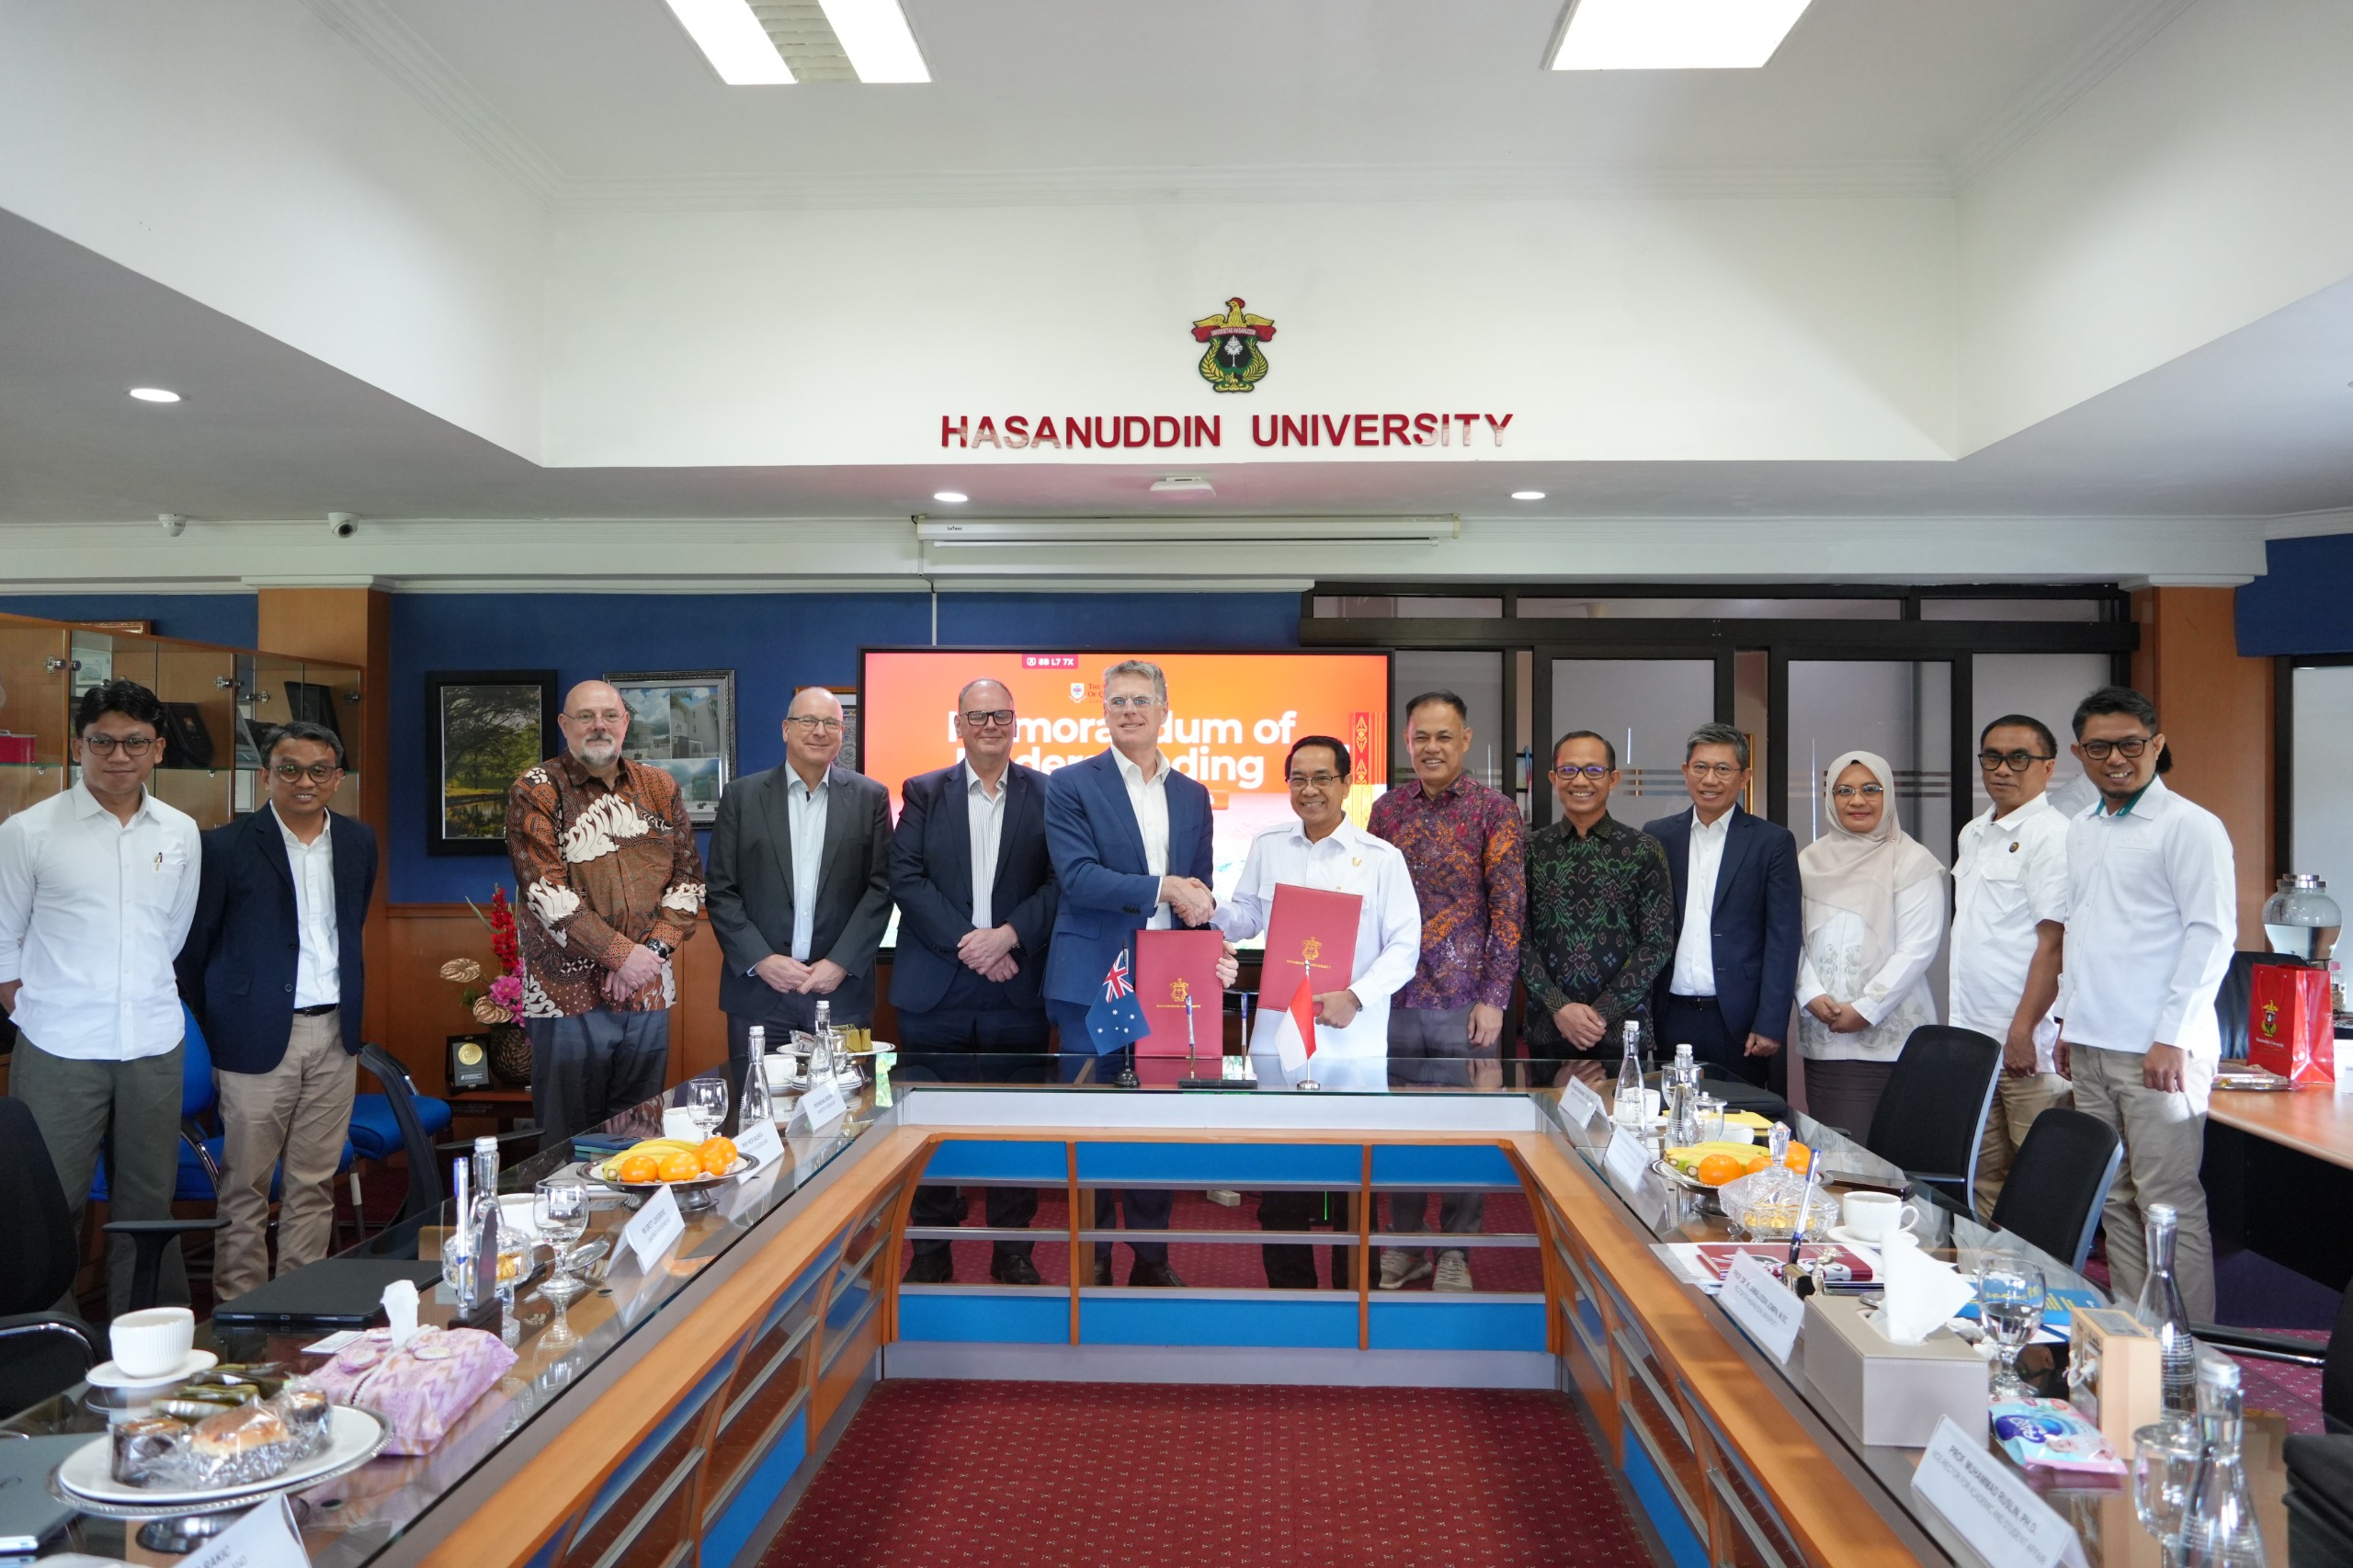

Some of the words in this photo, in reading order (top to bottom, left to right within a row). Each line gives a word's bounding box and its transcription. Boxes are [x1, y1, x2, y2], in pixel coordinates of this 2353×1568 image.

[941, 415, 1221, 449] HASANUDDIN
[1252, 413, 1514, 447] UNIVERSITY
[1051, 658, 1061, 666] L7
[1063, 658, 1074, 666] 7X
[1253, 710, 1298, 744] of
[1964, 1459, 2000, 1497] MUHAMMAD
